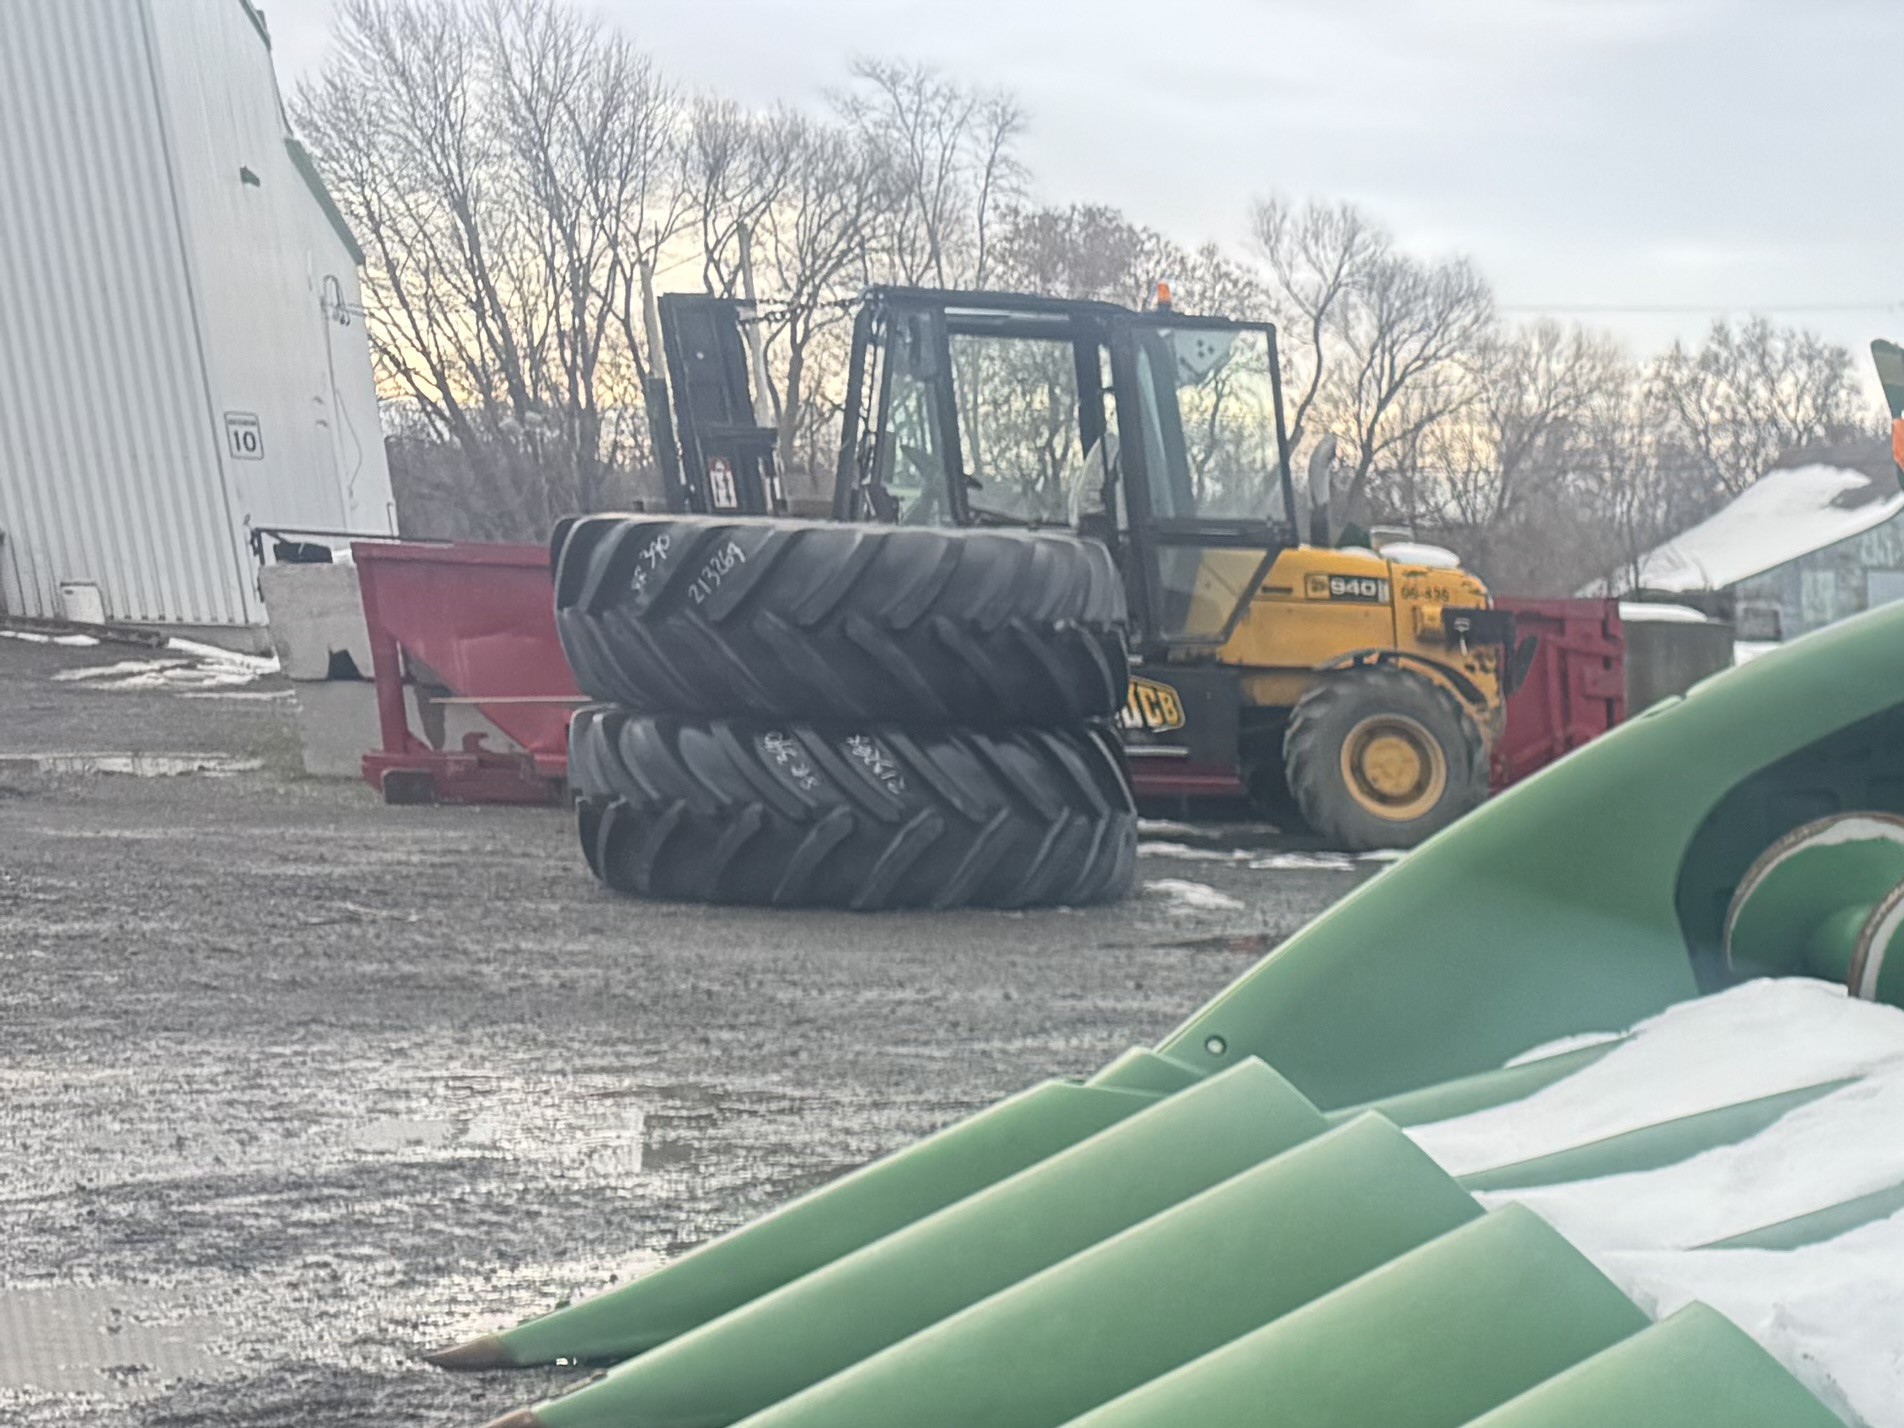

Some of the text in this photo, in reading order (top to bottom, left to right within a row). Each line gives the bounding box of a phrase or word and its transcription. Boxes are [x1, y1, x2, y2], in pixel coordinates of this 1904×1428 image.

[233, 430, 256, 452] 10
[1330, 576, 1377, 597] 940
[1121, 682, 1180, 728] JCB
